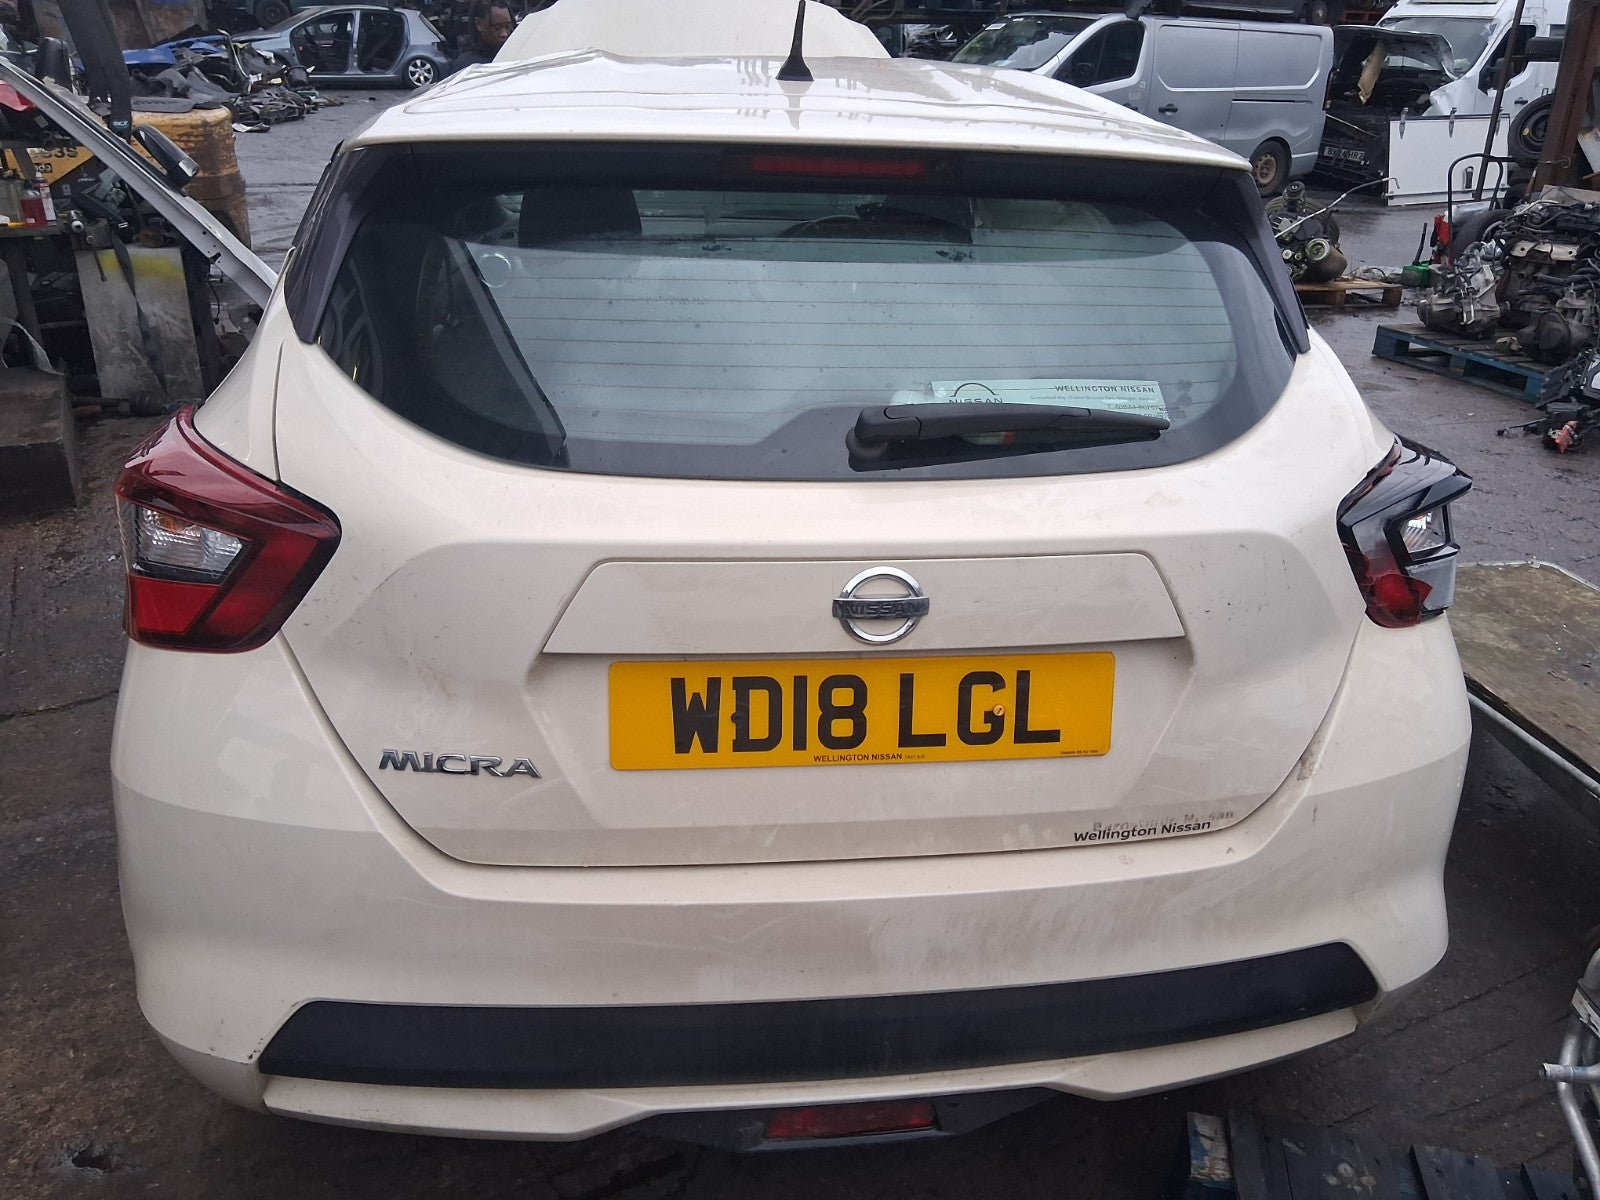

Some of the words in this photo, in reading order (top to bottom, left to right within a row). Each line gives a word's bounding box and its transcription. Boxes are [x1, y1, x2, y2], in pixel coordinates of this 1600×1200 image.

[1120, 385, 1155, 394] NISSAN
[844, 600, 925, 618] NISSAN
[671, 674, 869, 754] WD18
[897, 669, 1061, 747] LGL
[378, 748, 543, 779] MICRA
[813, 754, 869, 762] WELLINGTON
[871, 753, 902, 761] NISSAN
[1073, 825, 1157, 842] Wellington
[1161, 821, 1211, 835] Nissan
